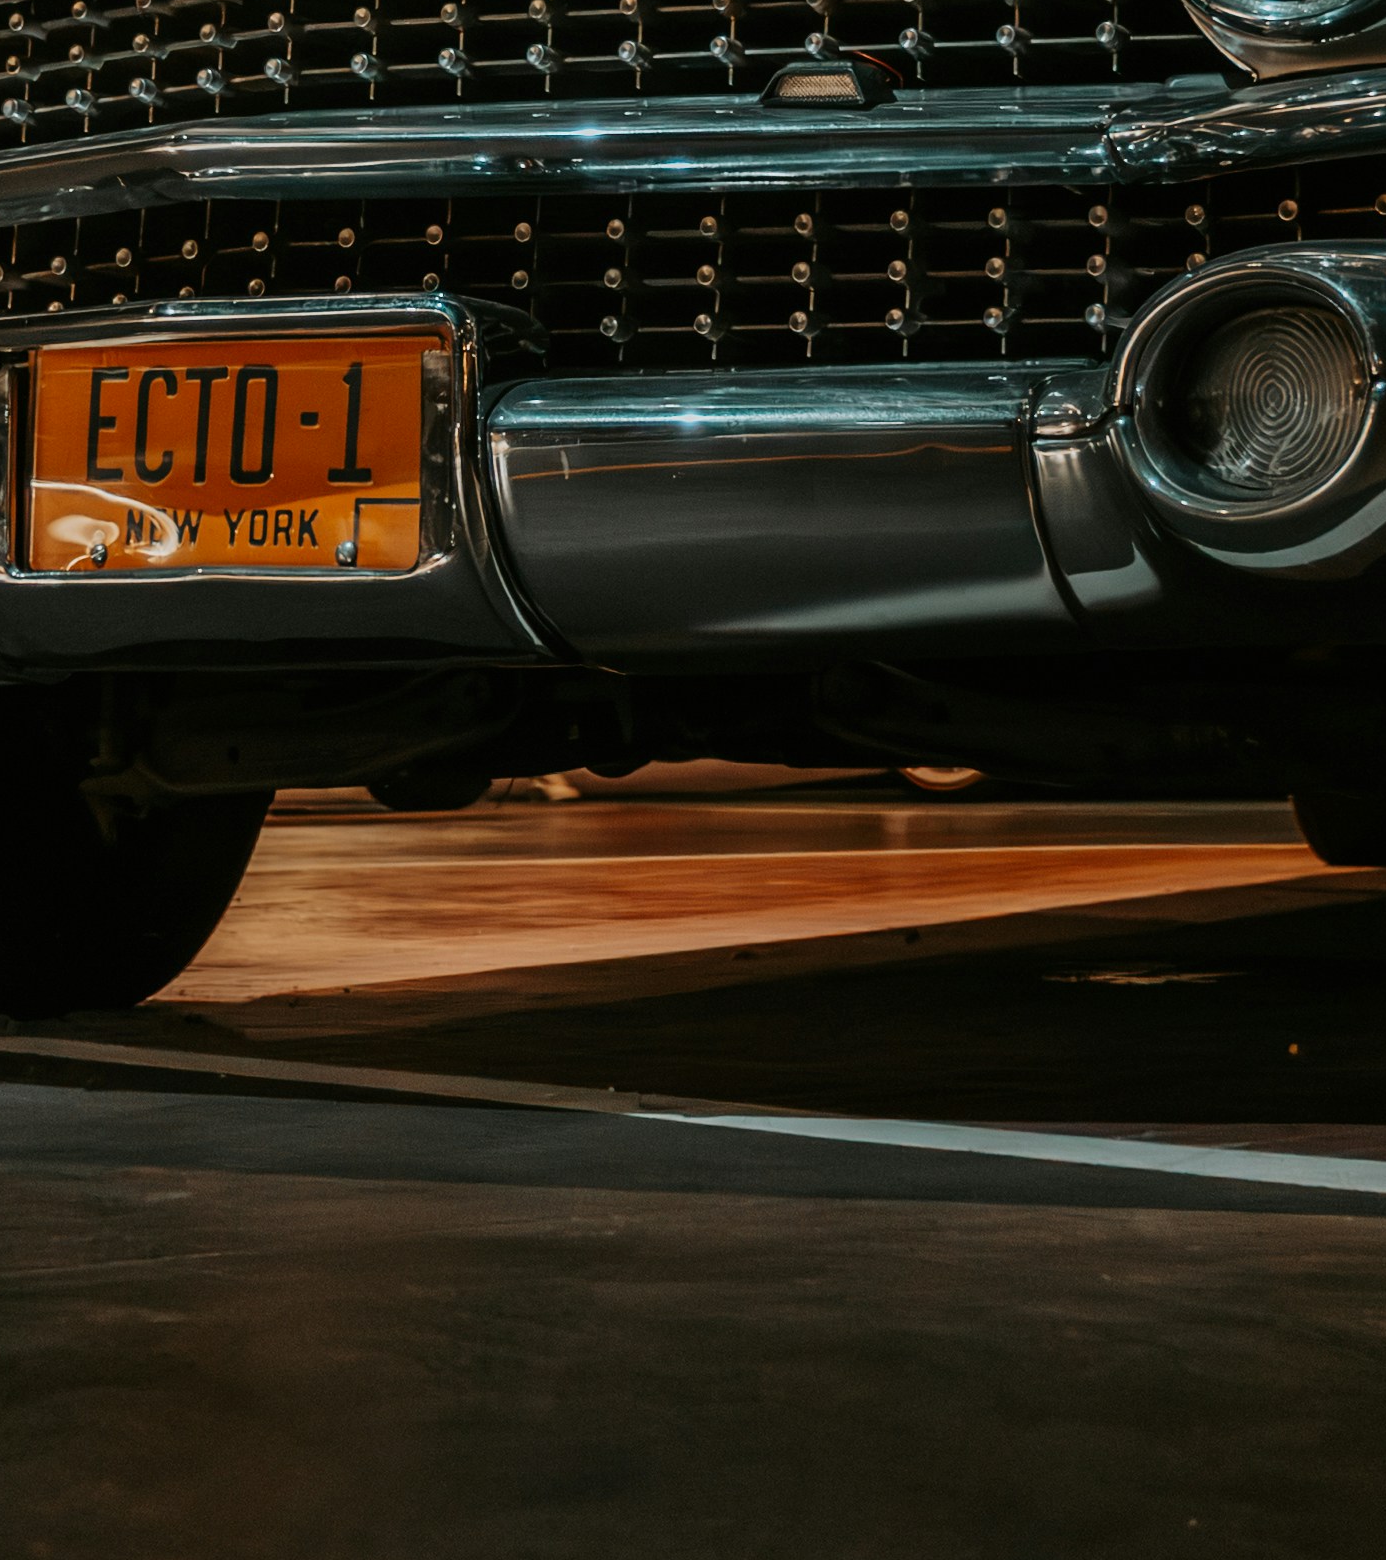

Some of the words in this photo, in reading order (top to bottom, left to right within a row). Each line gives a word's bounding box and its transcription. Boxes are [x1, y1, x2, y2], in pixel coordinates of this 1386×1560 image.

[85, 361, 374, 486] ECTO-1
[125, 508, 203, 548] NEW
[223, 508, 319, 548] YORK
